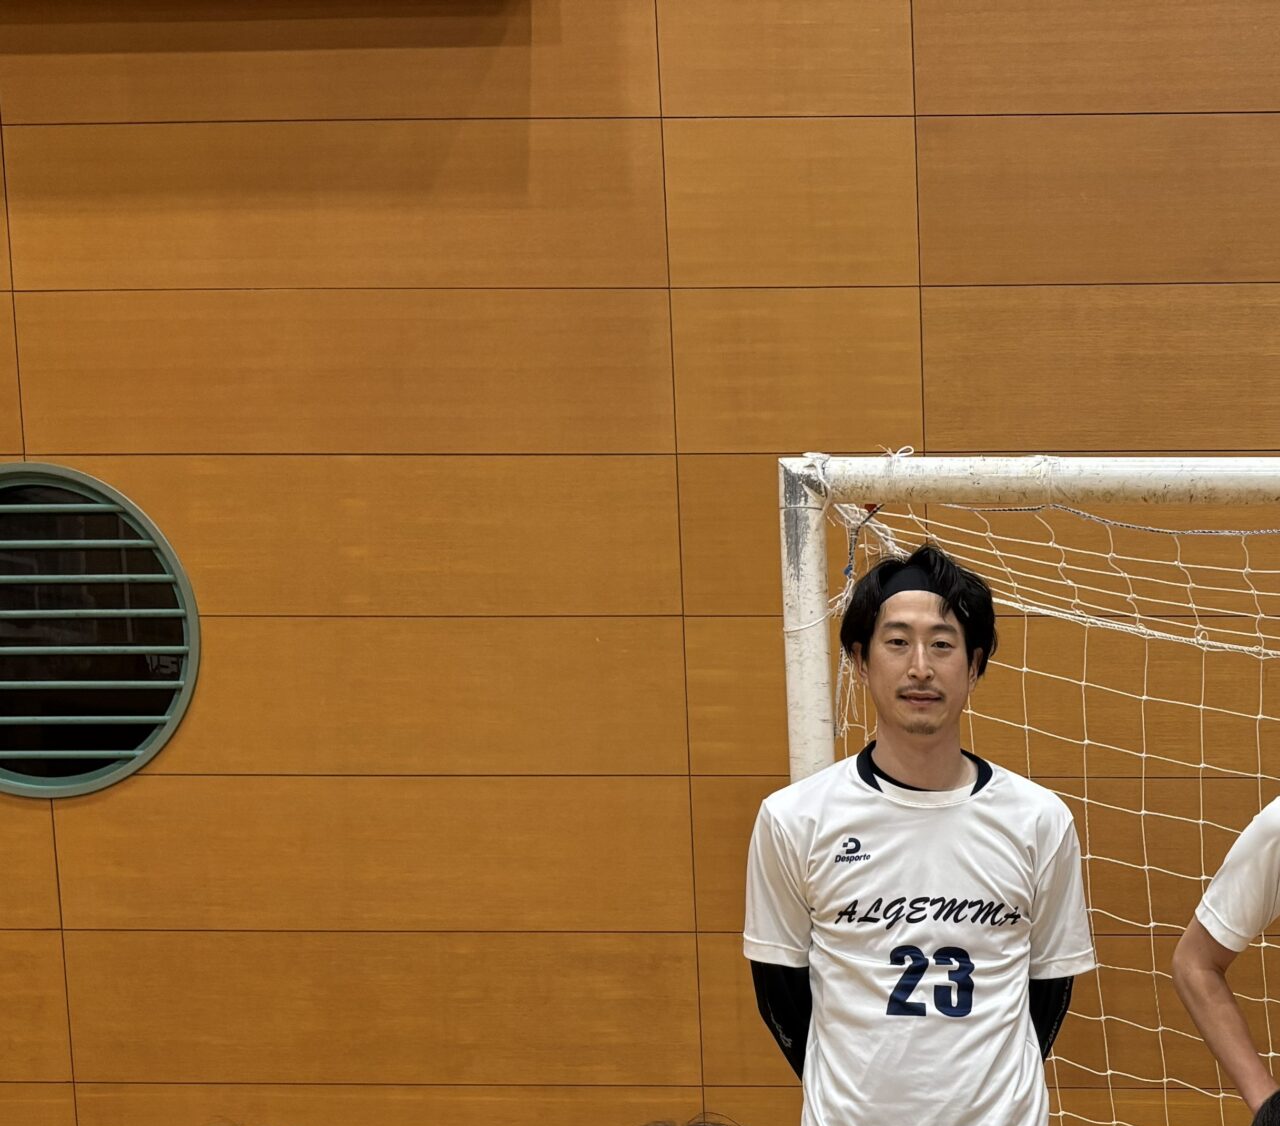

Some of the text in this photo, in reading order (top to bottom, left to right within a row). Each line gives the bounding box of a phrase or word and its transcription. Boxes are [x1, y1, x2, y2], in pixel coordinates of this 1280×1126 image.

[834, 852, 871, 864] Desporte
[834, 896, 1022, 930] ALGEMMA
[886, 945, 975, 1018] 23
